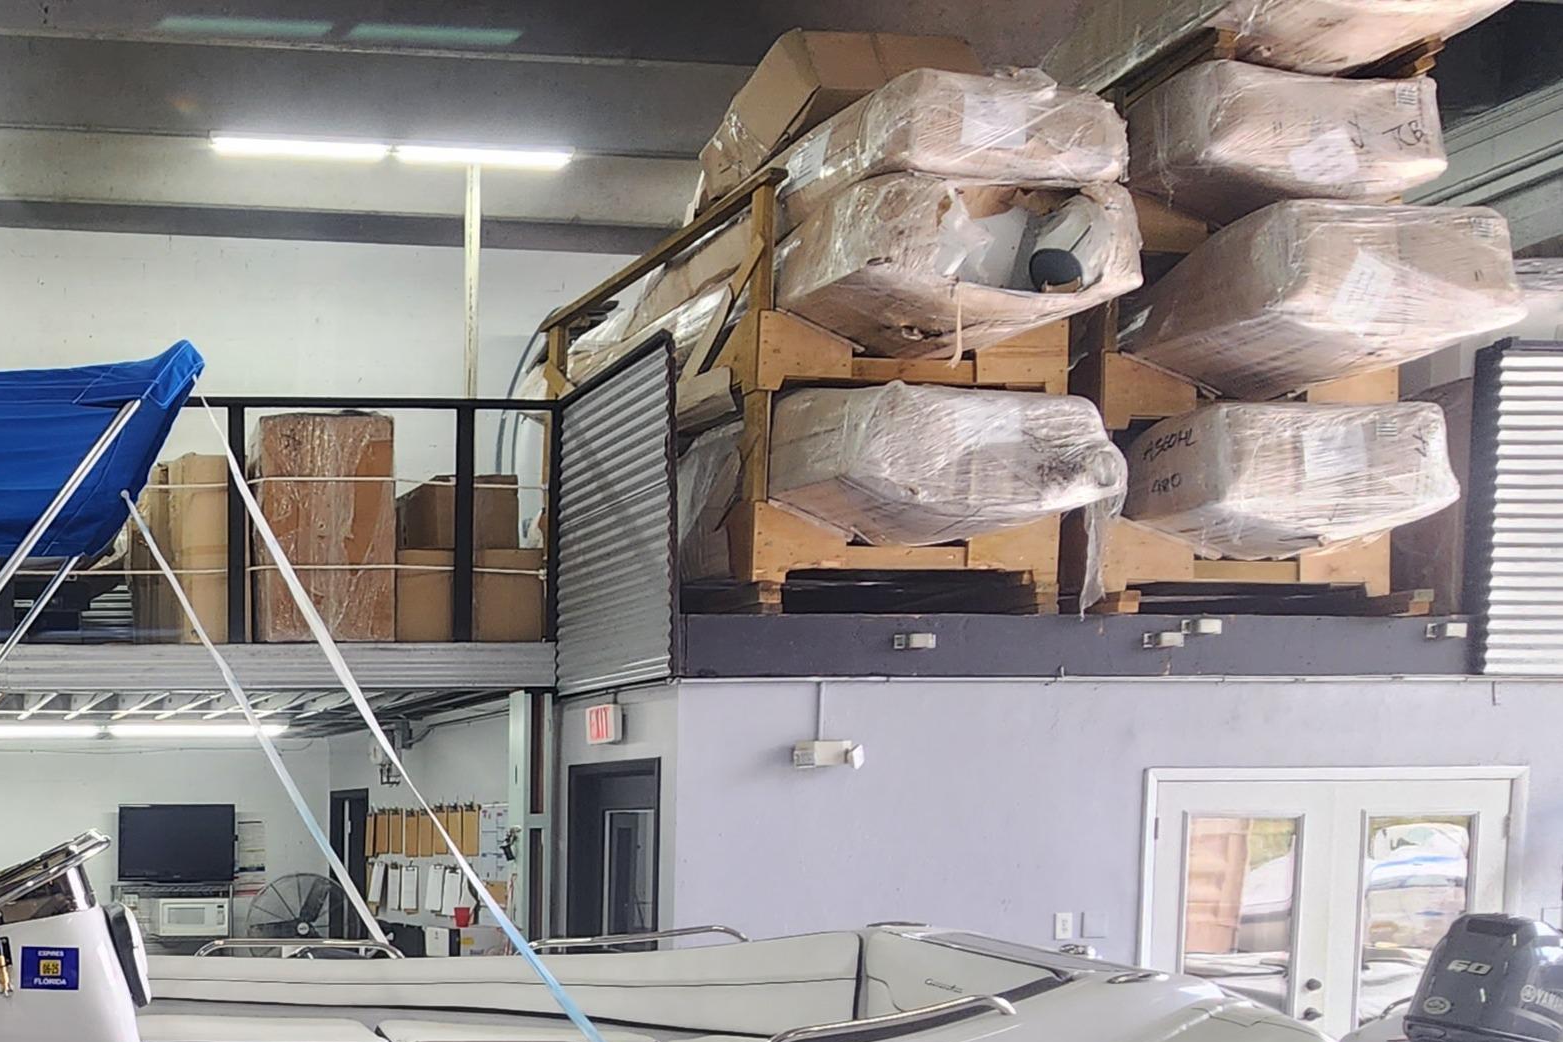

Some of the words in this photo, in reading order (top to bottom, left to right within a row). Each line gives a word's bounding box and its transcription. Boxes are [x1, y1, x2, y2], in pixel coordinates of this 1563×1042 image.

[589, 706, 611, 740] EXIT
[1447, 959, 1493, 975] 60
[33, 977, 67, 985] FLORIDA
